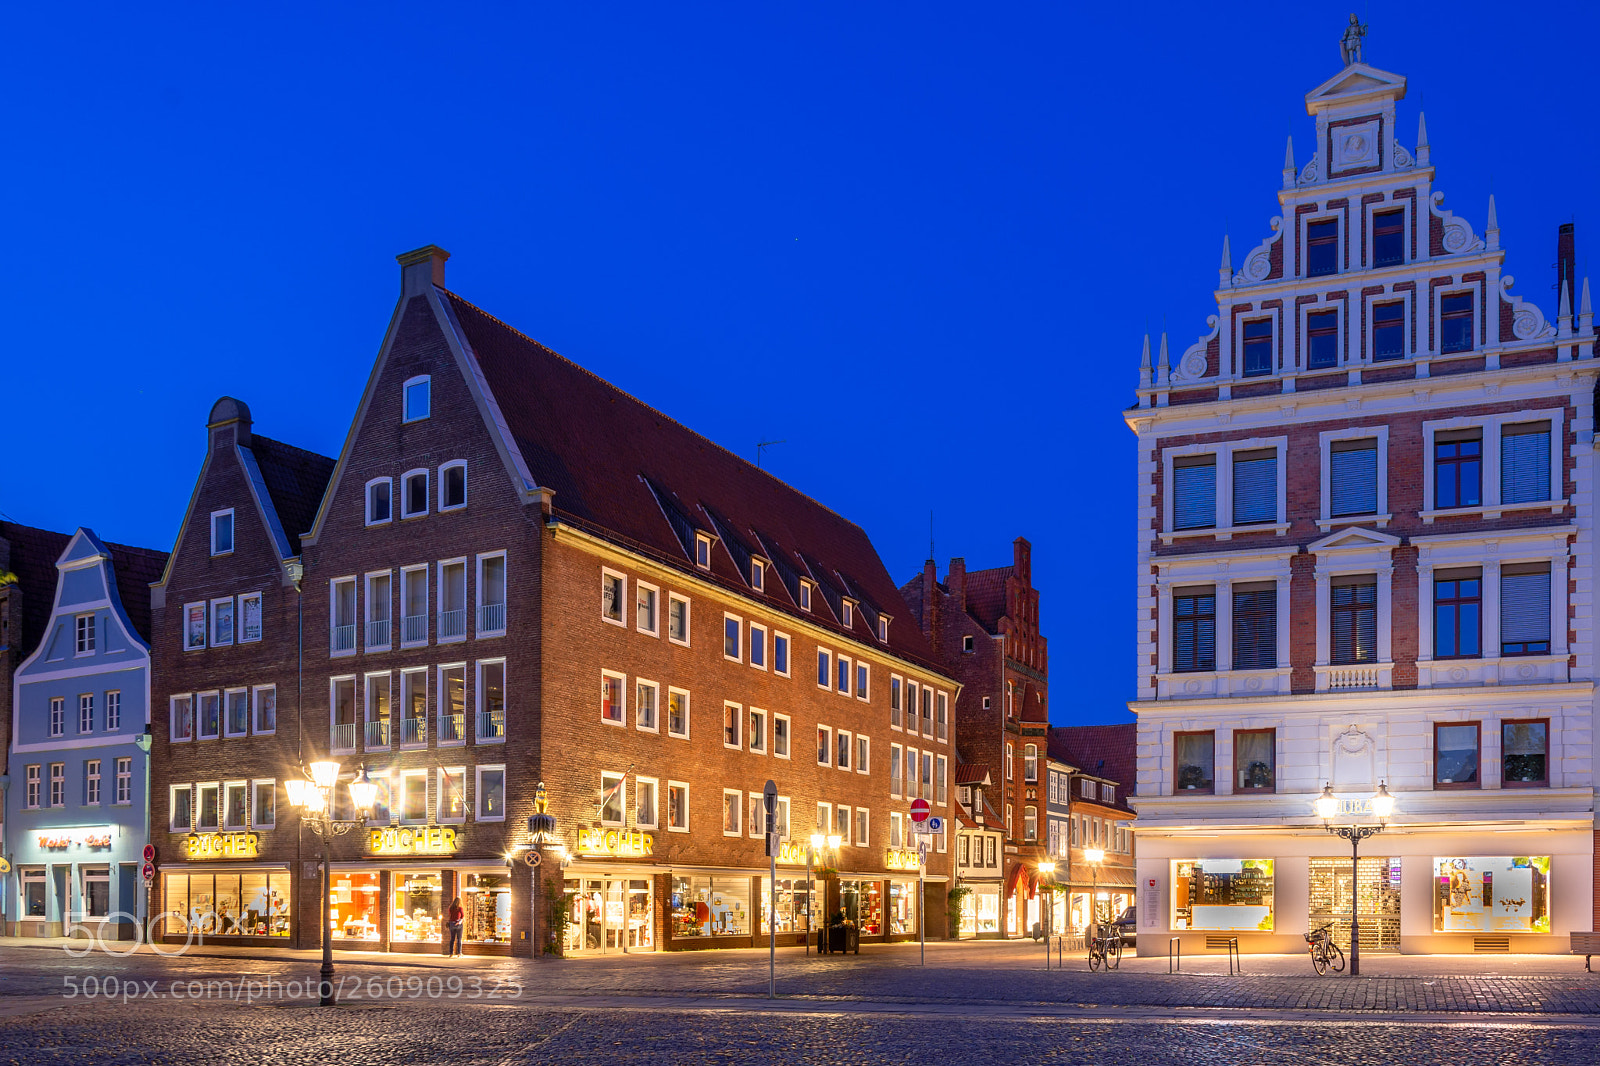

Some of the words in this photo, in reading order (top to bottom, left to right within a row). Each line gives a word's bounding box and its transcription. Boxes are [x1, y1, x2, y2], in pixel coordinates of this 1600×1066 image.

[188, 833, 259, 857] BÜCHER
[371, 828, 458, 852] BÜCHER
[578, 828, 654, 856] BÜCHER
[775, 842, 820, 864] ÜCHR
